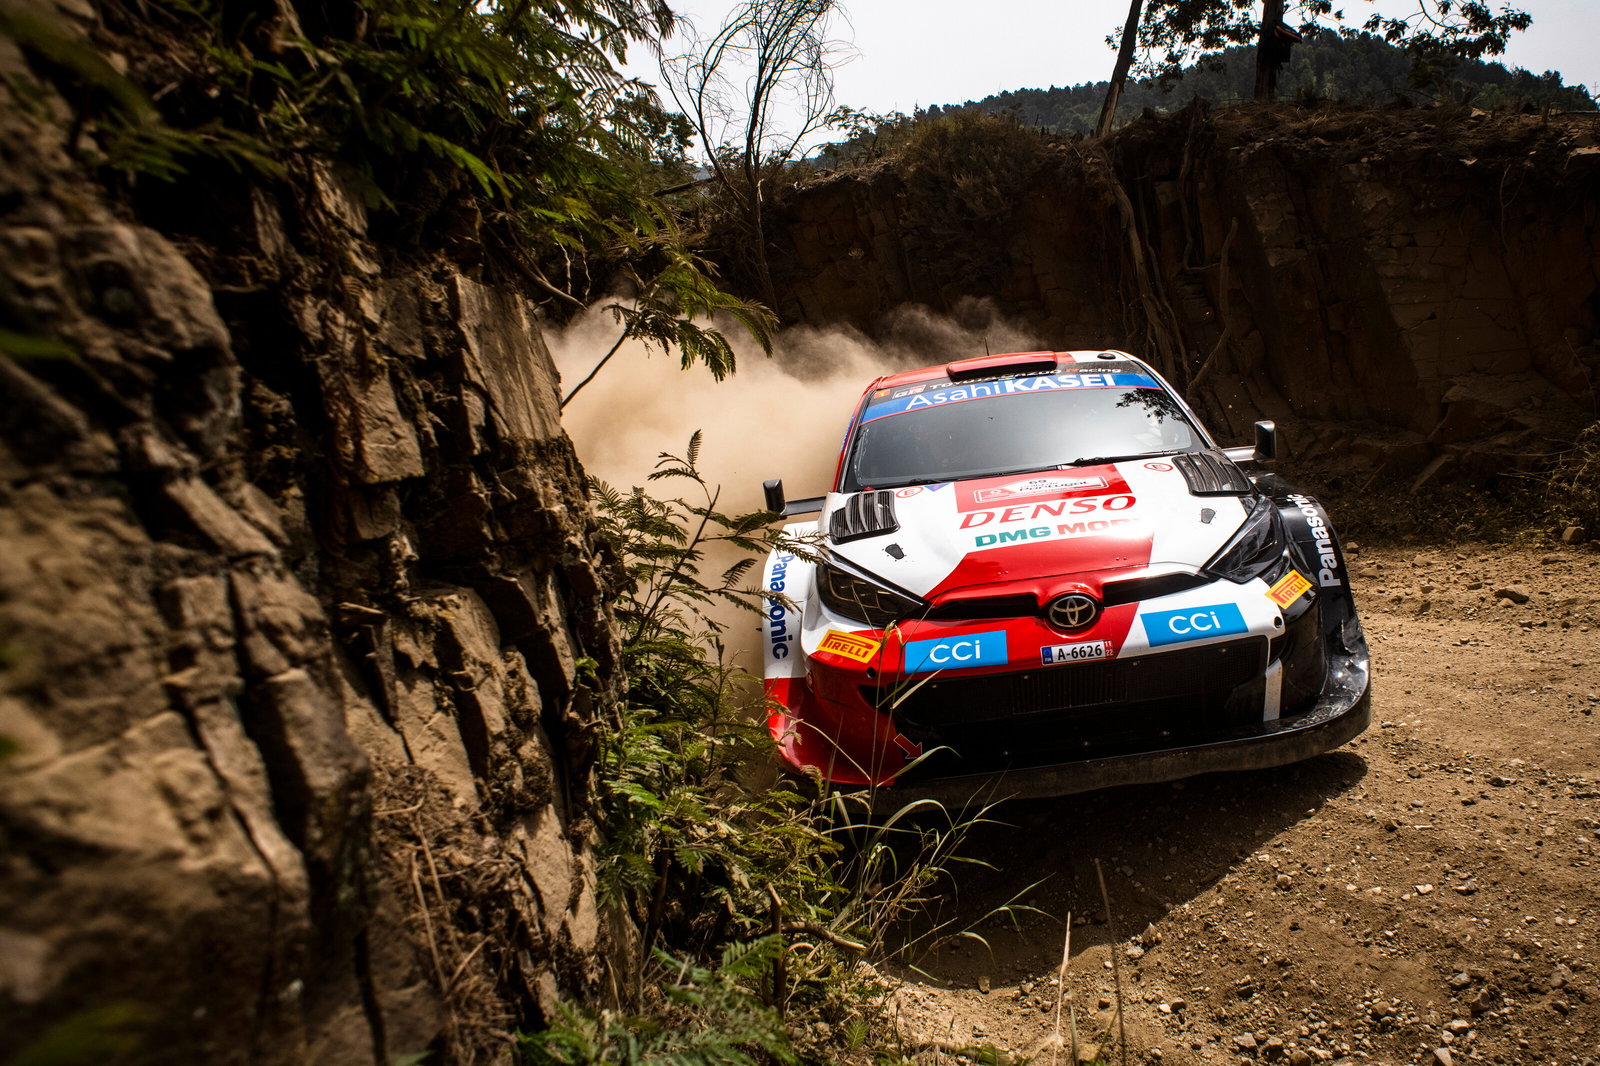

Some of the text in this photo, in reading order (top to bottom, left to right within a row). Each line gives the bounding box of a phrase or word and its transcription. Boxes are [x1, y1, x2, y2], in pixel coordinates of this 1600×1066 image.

[959, 495, 1137, 530] DENSO
[974, 526, 1051, 547] DMG
[1285, 493, 1341, 588] Panasonic
[1271, 573, 1308, 605] PIRELLI
[821, 633, 875, 659] PIRELLI
[1057, 644, 1103, 660] A-6626
